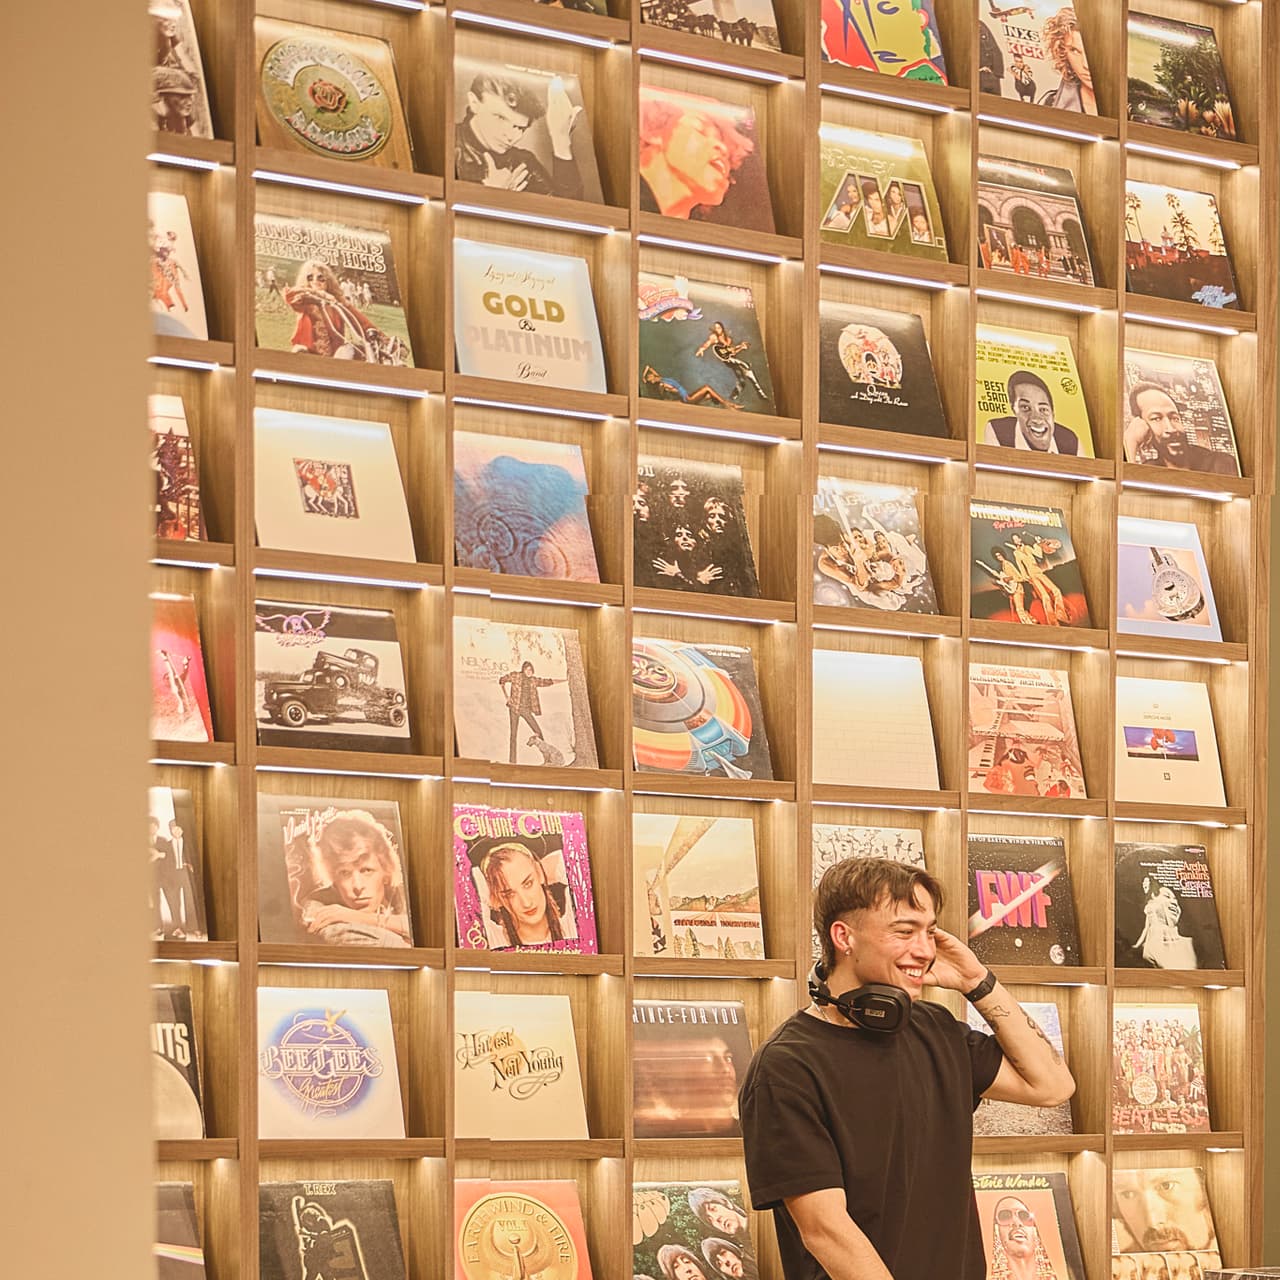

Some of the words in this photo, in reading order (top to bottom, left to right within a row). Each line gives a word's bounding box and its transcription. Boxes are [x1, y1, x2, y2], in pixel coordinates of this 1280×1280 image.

[1002, 25, 1040, 42] INXS
[1007, 42, 1044, 59] KICK
[256, 223, 301, 242] ANIS
[341, 250, 387, 273] HITS
[482, 291, 565, 323] GOLD
[466, 325, 593, 361] PLATINUM
[516, 361, 548, 379] Band
[983, 380, 1005, 392] BEST
[986, 392, 1008, 403] SAM
[453, 814, 516, 840] CULTURE
[518, 813, 563, 838] CLUB
[1183, 861, 1209, 873] Aretha
[711, 1007, 739, 1025] YOU
[157, 1023, 191, 1068] ITS
[1005, 1174, 1050, 1189] Wonder
